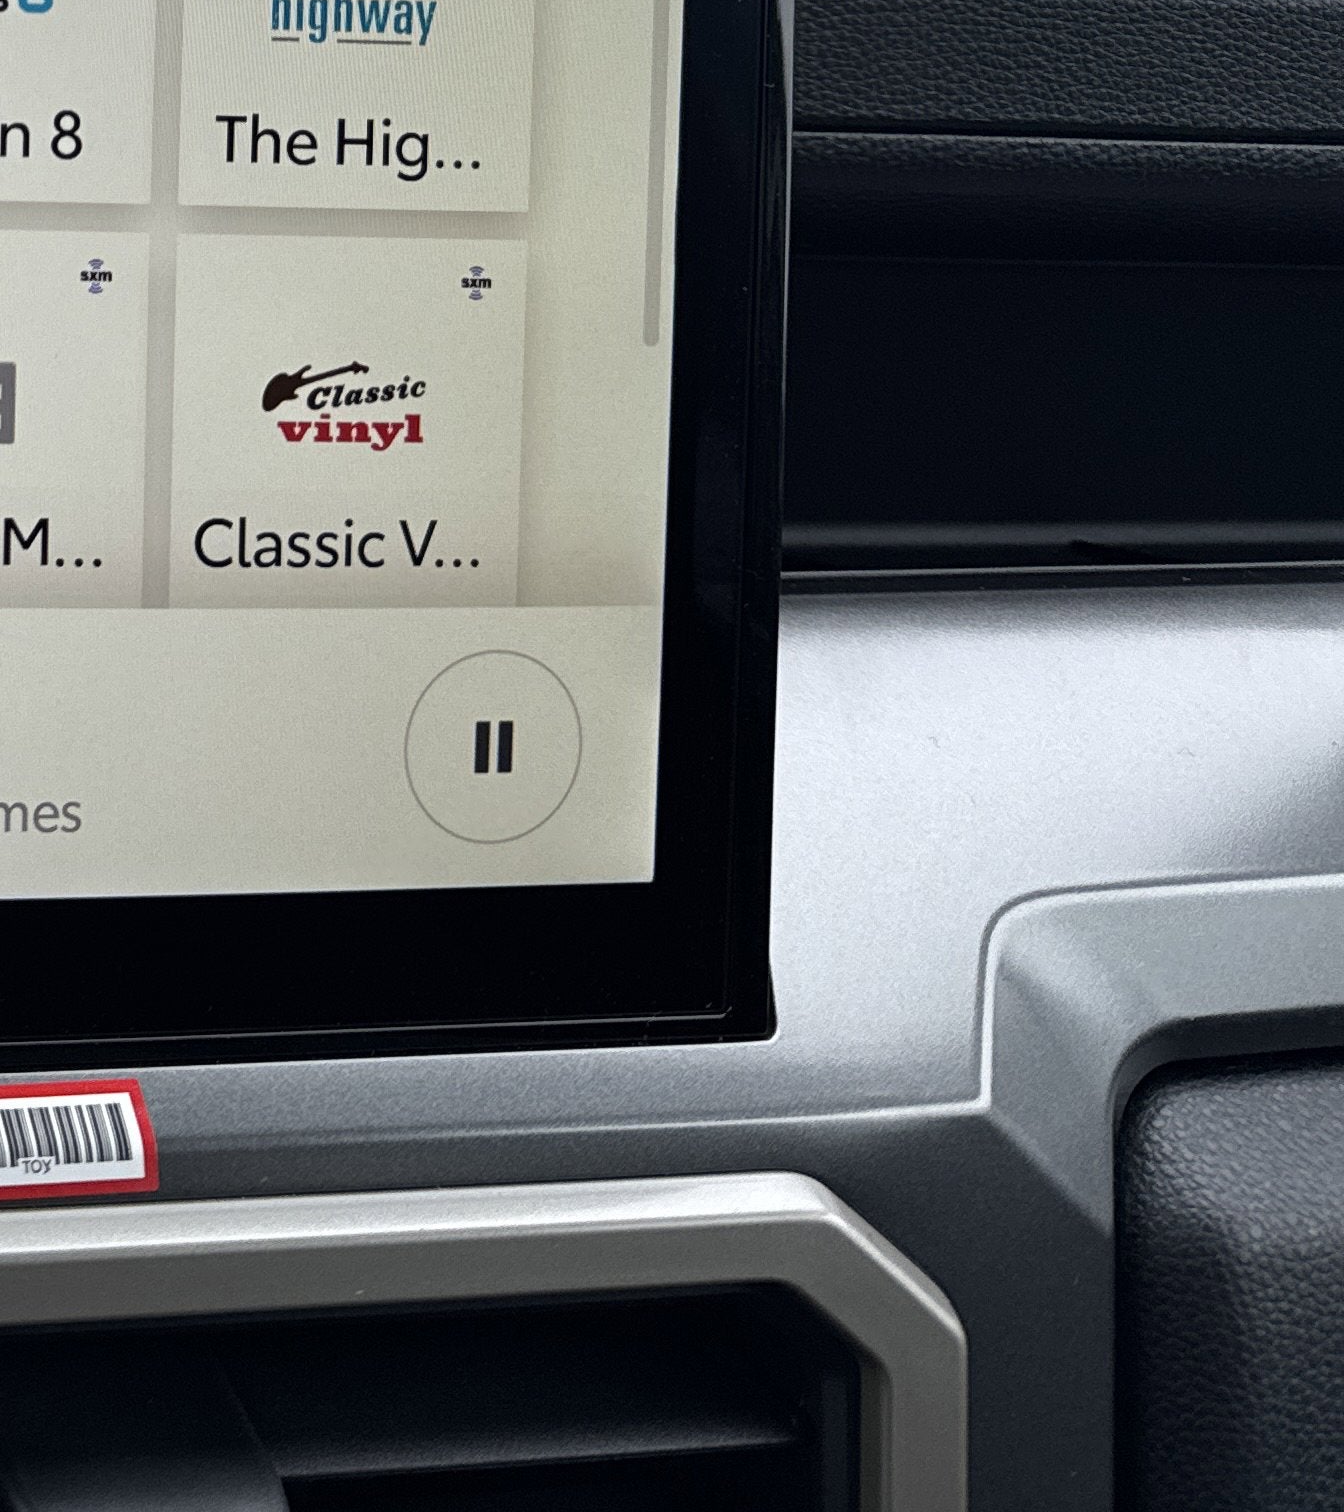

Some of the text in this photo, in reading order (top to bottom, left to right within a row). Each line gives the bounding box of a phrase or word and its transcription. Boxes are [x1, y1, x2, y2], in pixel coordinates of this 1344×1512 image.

[51, 111, 82, 159] 8
[216, 114, 317, 165] The
[306, 375, 427, 410] Classic
[277, 413, 424, 452] vinyl
[195, 517, 385, 567] Classic
